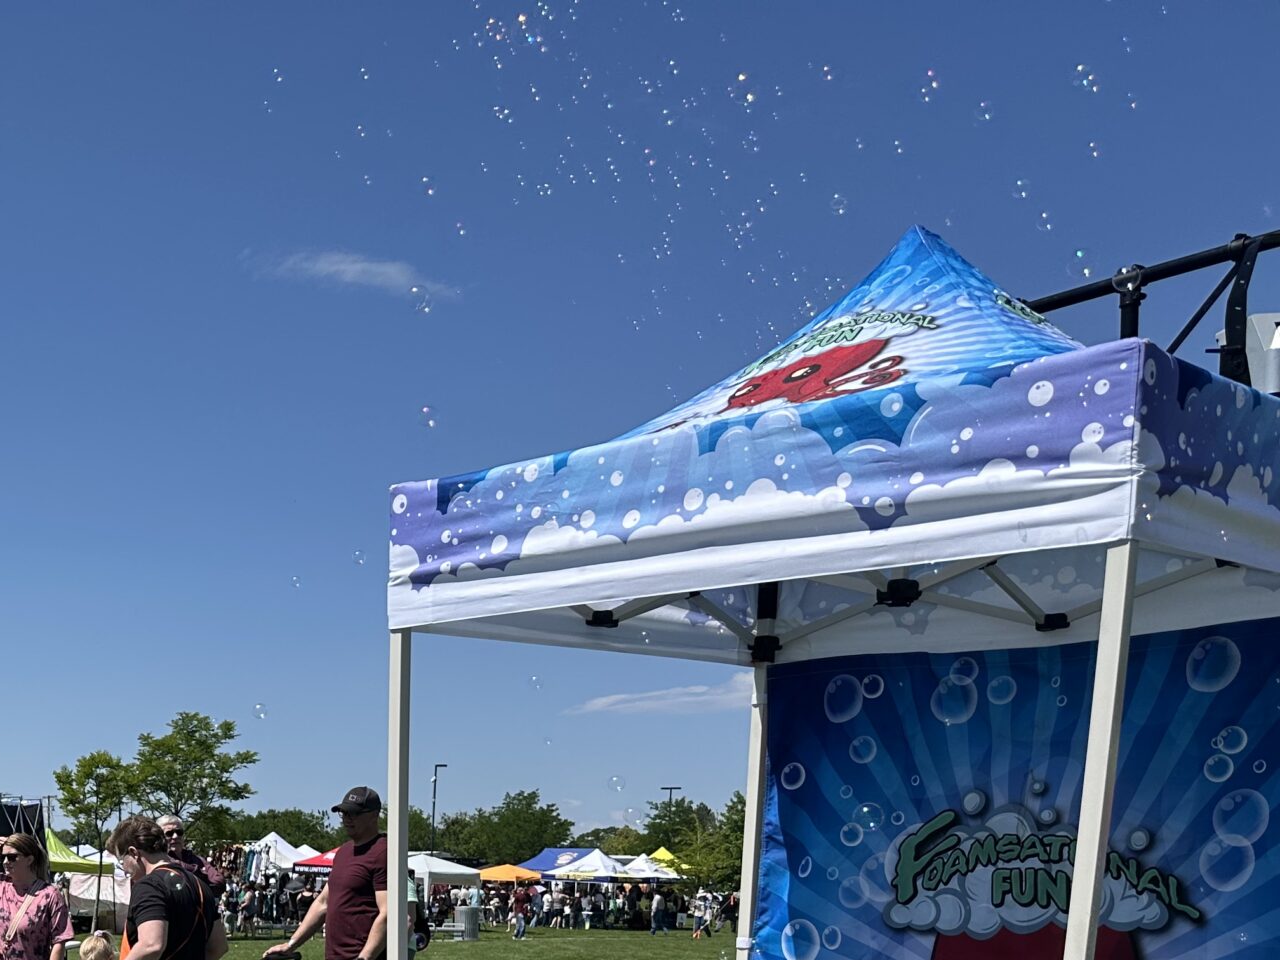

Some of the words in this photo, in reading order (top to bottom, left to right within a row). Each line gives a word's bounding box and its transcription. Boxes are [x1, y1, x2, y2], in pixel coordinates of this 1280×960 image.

[803, 325, 863, 353] FUN
[892, 809, 1202, 920] FOAMSATINAL
[992, 867, 1070, 911] FUN
